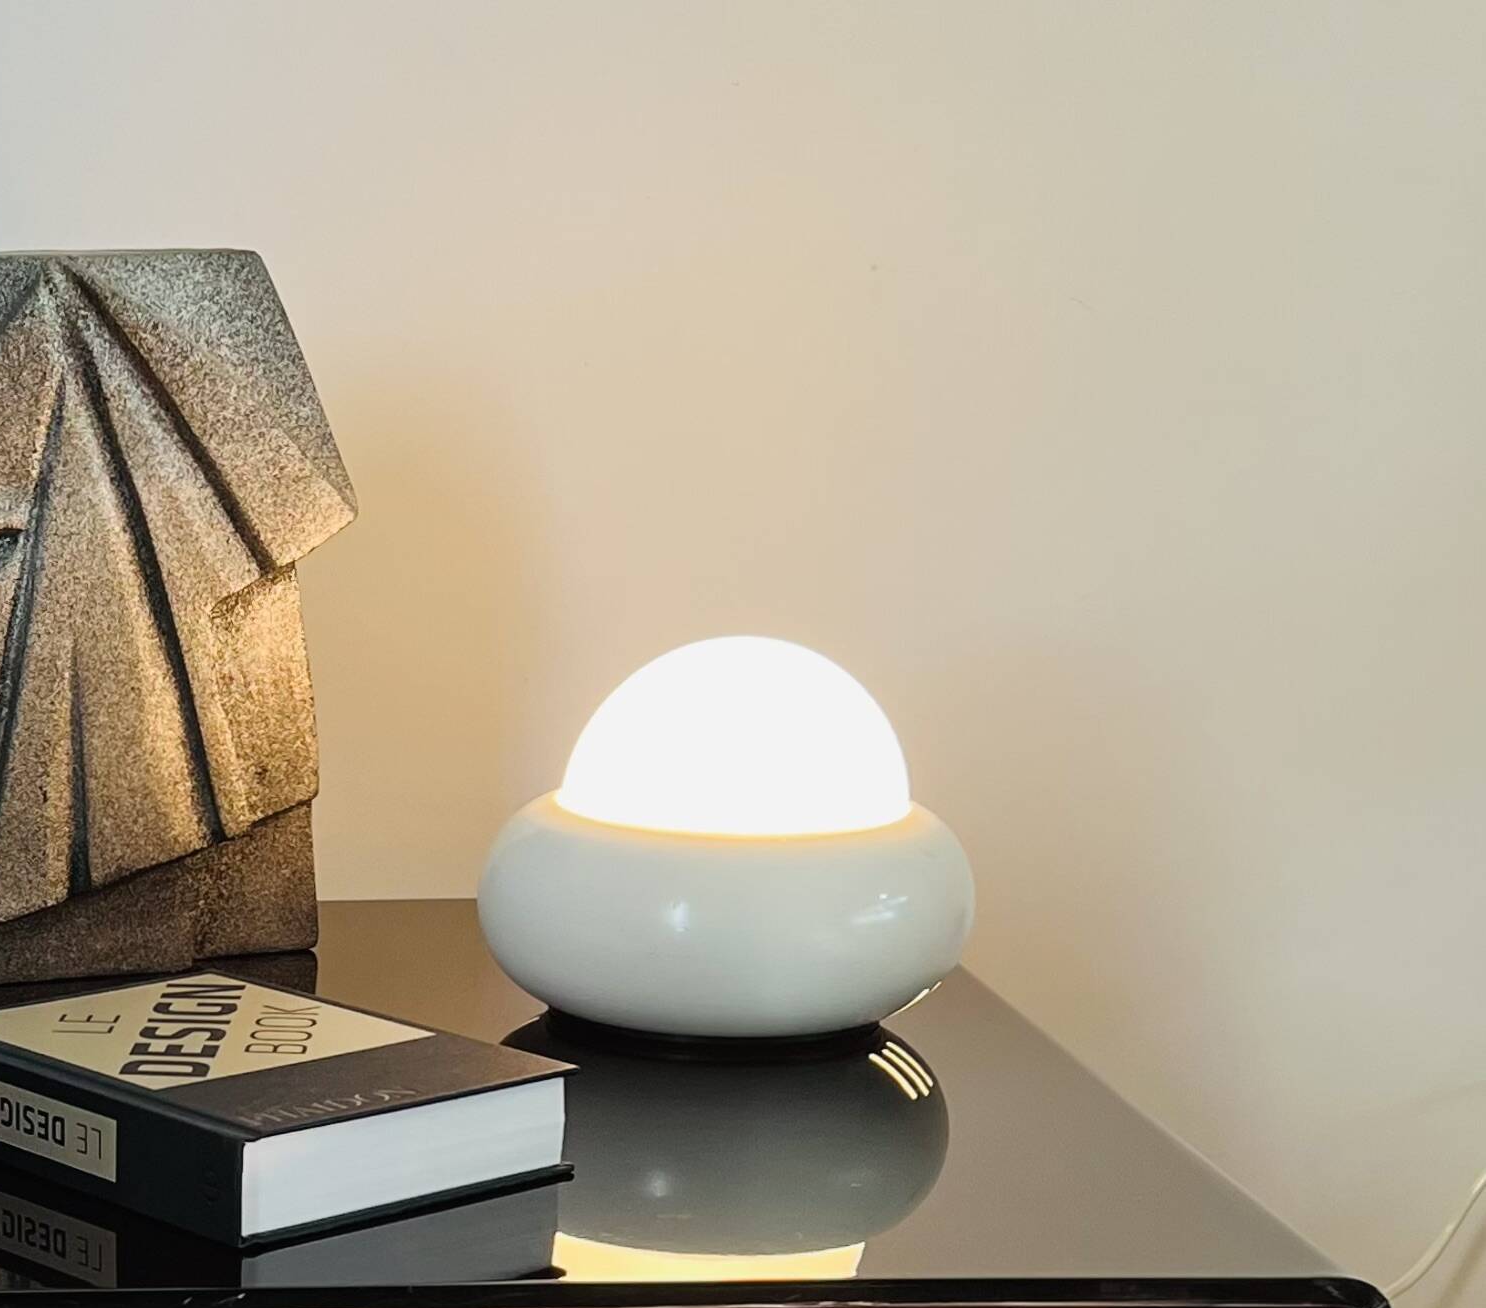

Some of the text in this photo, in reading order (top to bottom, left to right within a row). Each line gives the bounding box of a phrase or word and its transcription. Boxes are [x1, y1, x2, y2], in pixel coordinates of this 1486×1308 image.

[52, 1014, 121, 1033] LE
[119, 983, 246, 1077] DESIGN
[244, 1005, 322, 1054] BOOK
[76, 1122, 101, 1160] LE
